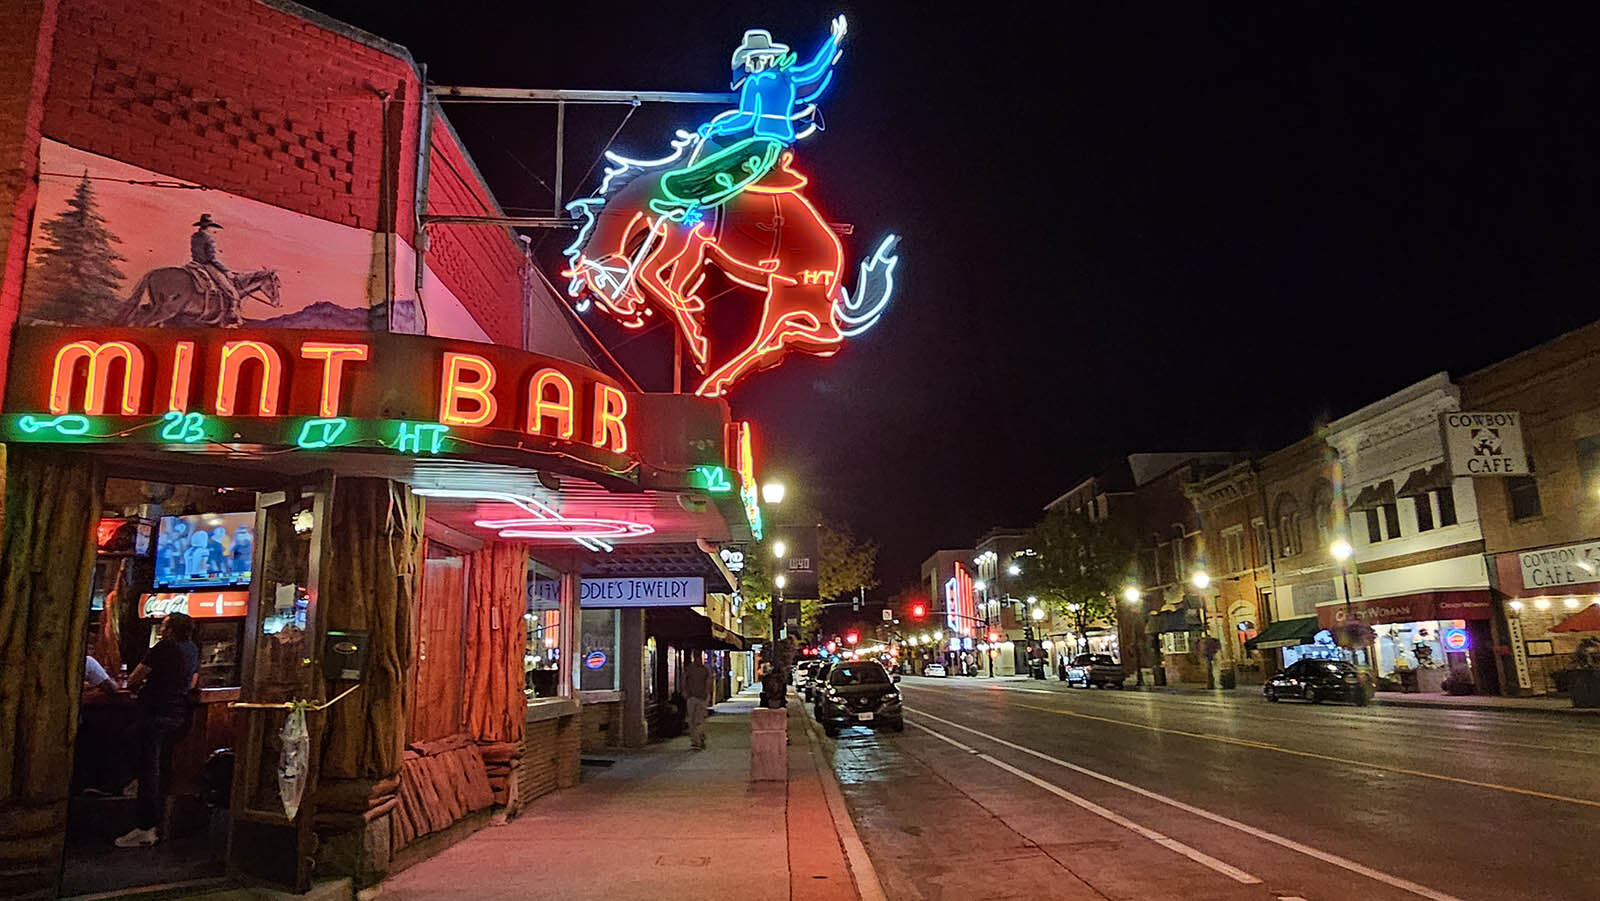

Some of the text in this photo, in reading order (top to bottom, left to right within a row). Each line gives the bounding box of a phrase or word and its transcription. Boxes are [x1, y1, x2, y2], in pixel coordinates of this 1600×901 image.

[803, 270, 835, 286] HT
[48, 341, 629, 456] MINT BAR
[1448, 414, 1516, 428] COWBOY
[398, 422, 450, 454] HT
[1467, 458, 1513, 473] CAFE
[1523, 547, 1577, 569] COWBOY
[1532, 565, 1576, 586] CAFE
[627, 580, 689, 600] JEWELRY
